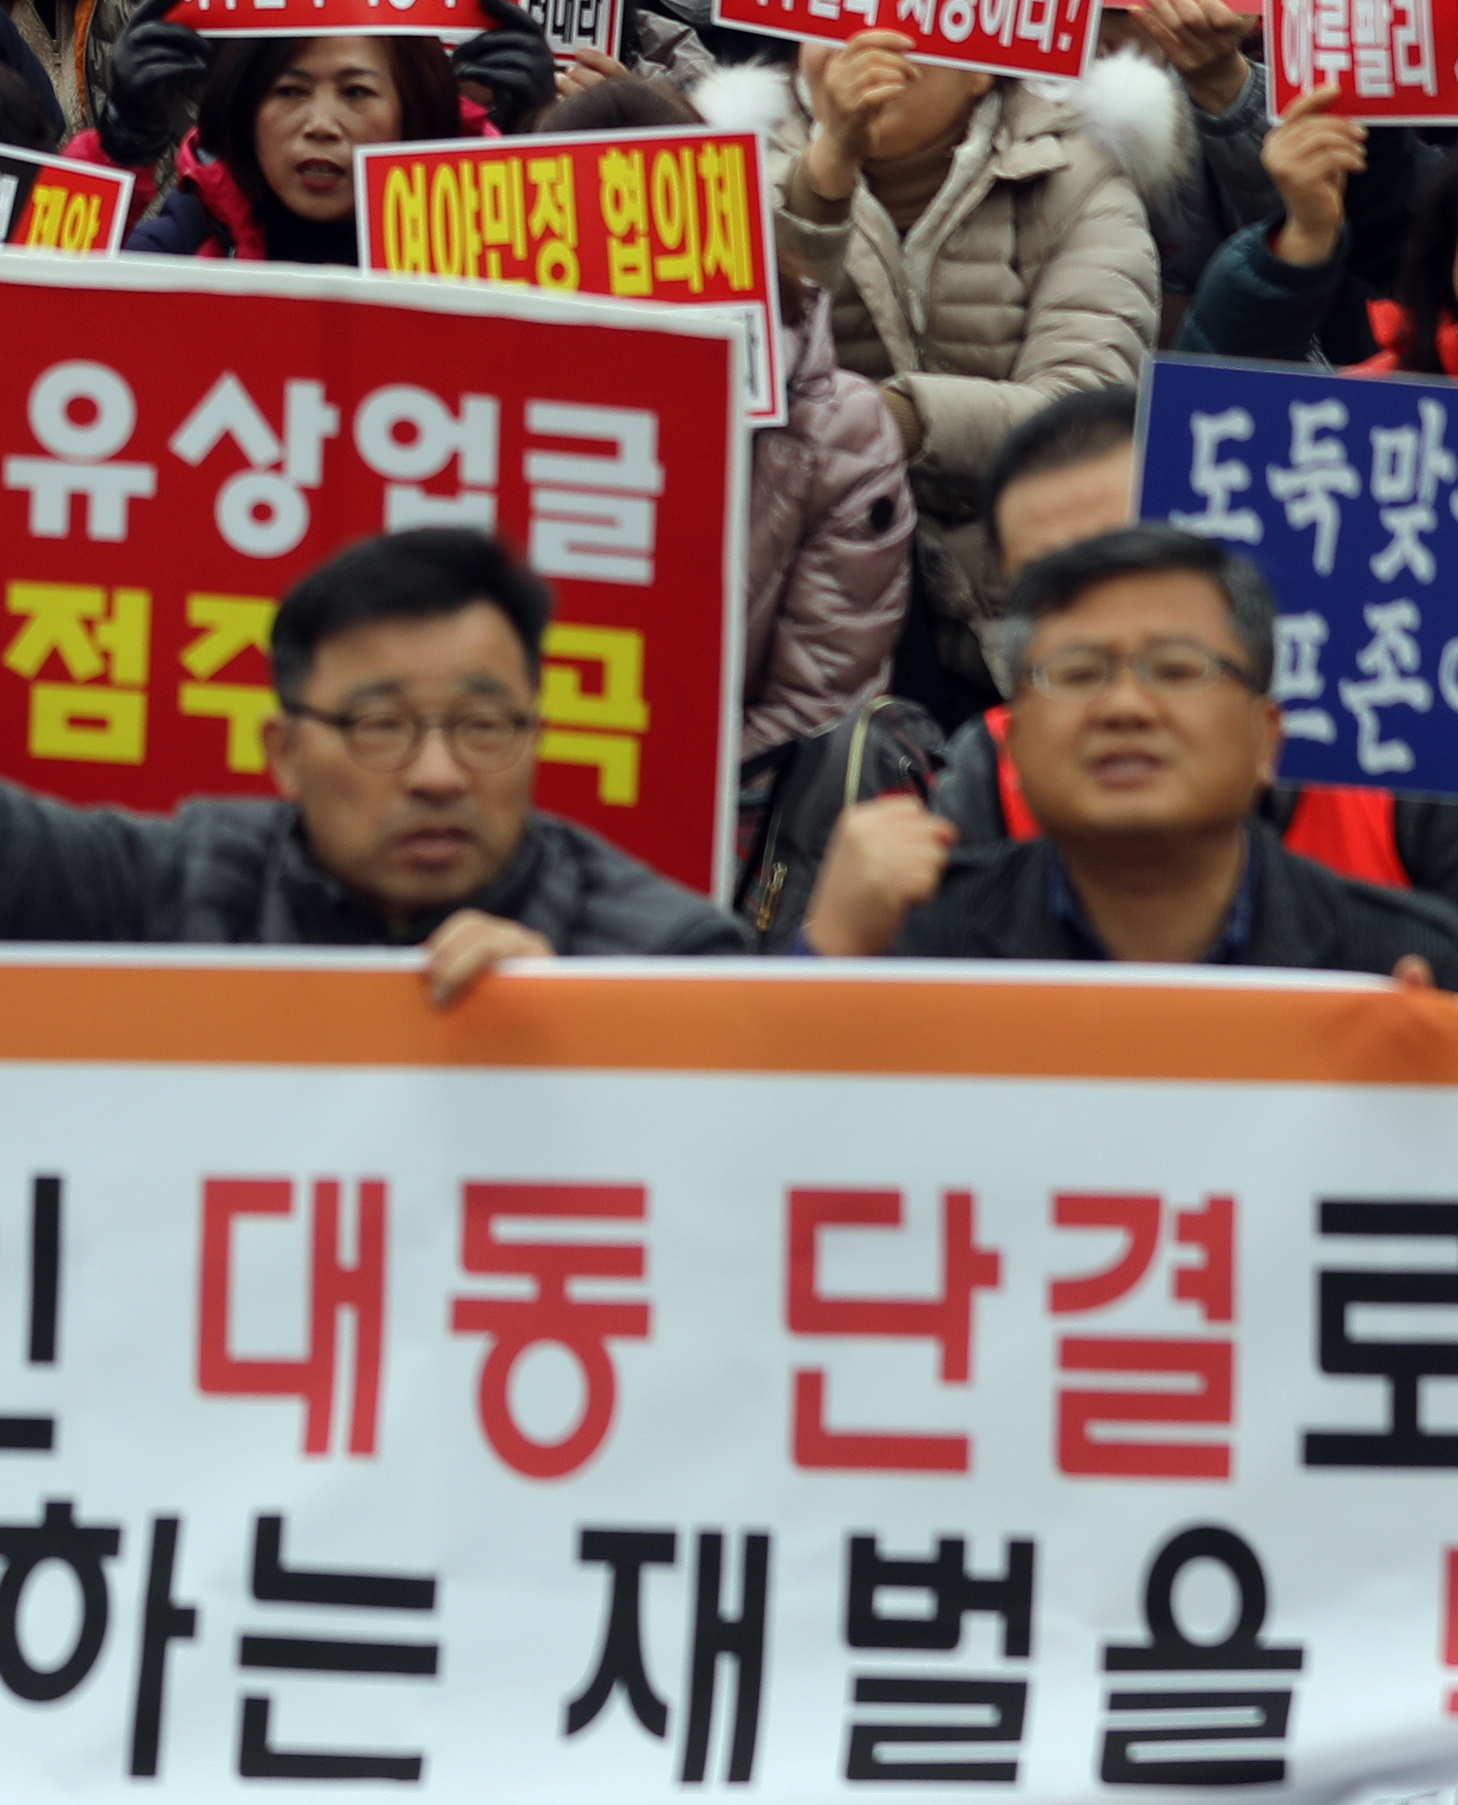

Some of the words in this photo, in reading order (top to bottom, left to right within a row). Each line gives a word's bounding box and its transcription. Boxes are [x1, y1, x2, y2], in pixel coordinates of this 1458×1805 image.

[3, 359, 665, 585] 유상업글
[192, 1173, 652, 1481] 대동
[564, 1521, 1307, 1789] 재벌을
